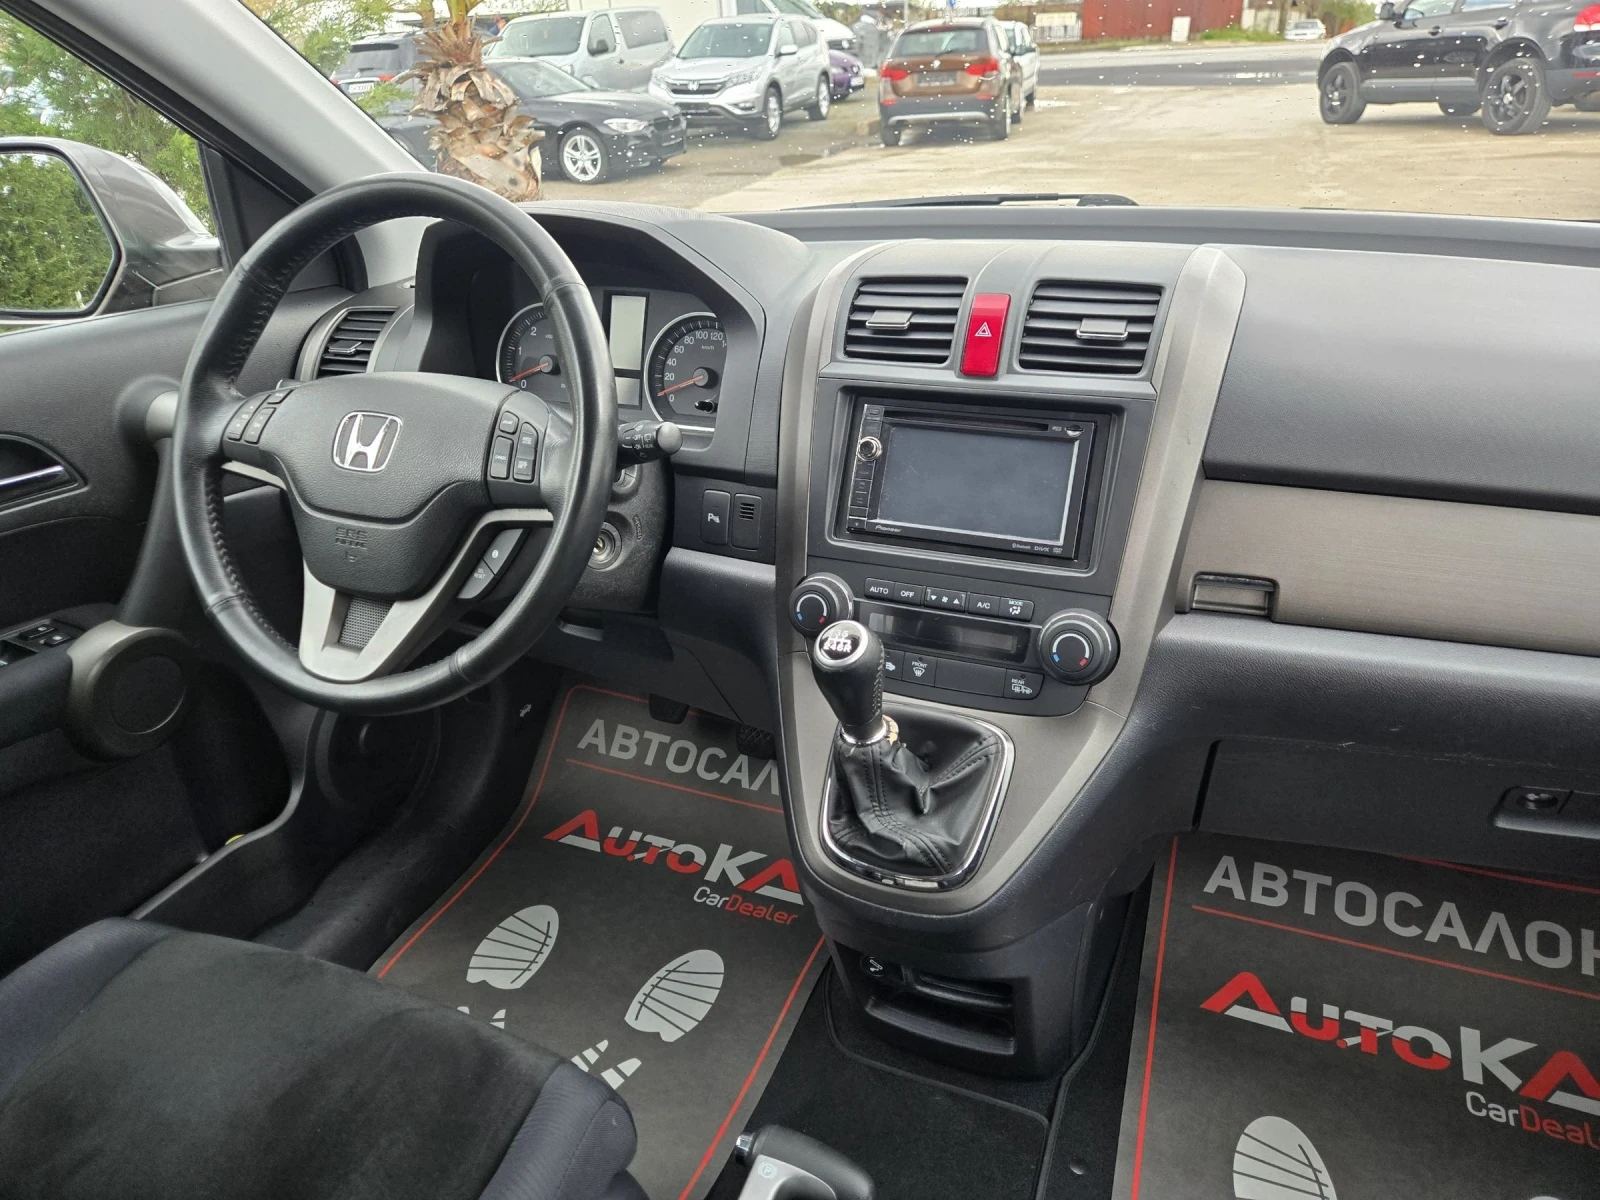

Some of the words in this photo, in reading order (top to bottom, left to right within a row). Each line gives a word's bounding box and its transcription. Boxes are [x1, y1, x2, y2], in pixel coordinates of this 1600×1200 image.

[530, 327, 537, 336] 2
[695, 331, 708, 339] 100
[684, 336, 694, 344] 80
[710, 332, 723, 340] 120
[518, 346, 522, 355] 1
[674, 345, 684, 353] 60
[666, 358, 677, 366] 40
[521, 379, 527, 388] 0
[875, 524, 902, 533] Pioneer
[869, 585, 889, 595] AUTO
[900, 590, 914, 598] OFF
[976, 601, 991, 609] A/C
[693, 886, 798, 926] CarDealer
